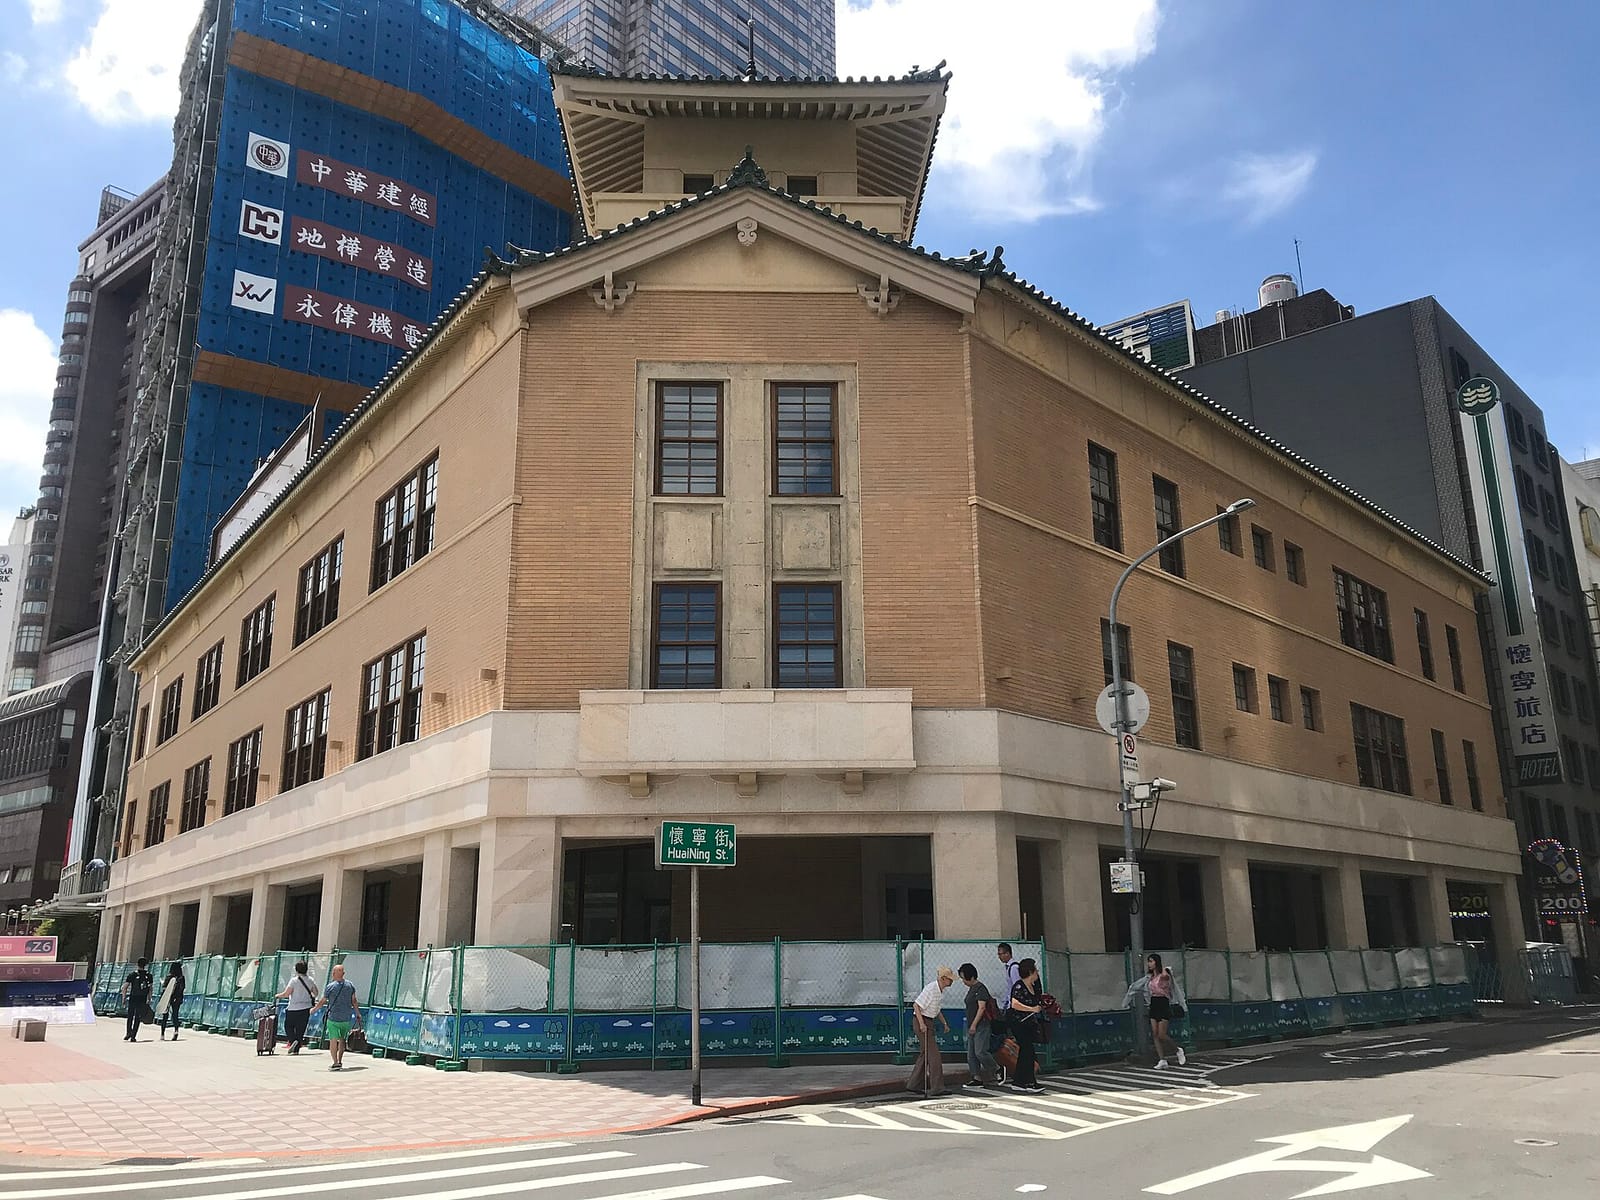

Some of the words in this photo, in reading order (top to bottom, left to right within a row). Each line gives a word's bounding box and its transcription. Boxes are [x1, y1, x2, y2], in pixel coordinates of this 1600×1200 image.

[310, 158, 430, 220] 中華建經
[297, 227, 428, 286] 地樺營造
[296, 294, 423, 349] 永偉機電
[1520, 757, 1559, 780] HOTEL
[668, 826, 729, 847] 懷寧街
[667, 847, 711, 863] HuaiNing
[715, 848, 729, 860] St.
[1542, 897, 1582, 909] 200
[31, 941, 52, 952] Z6
